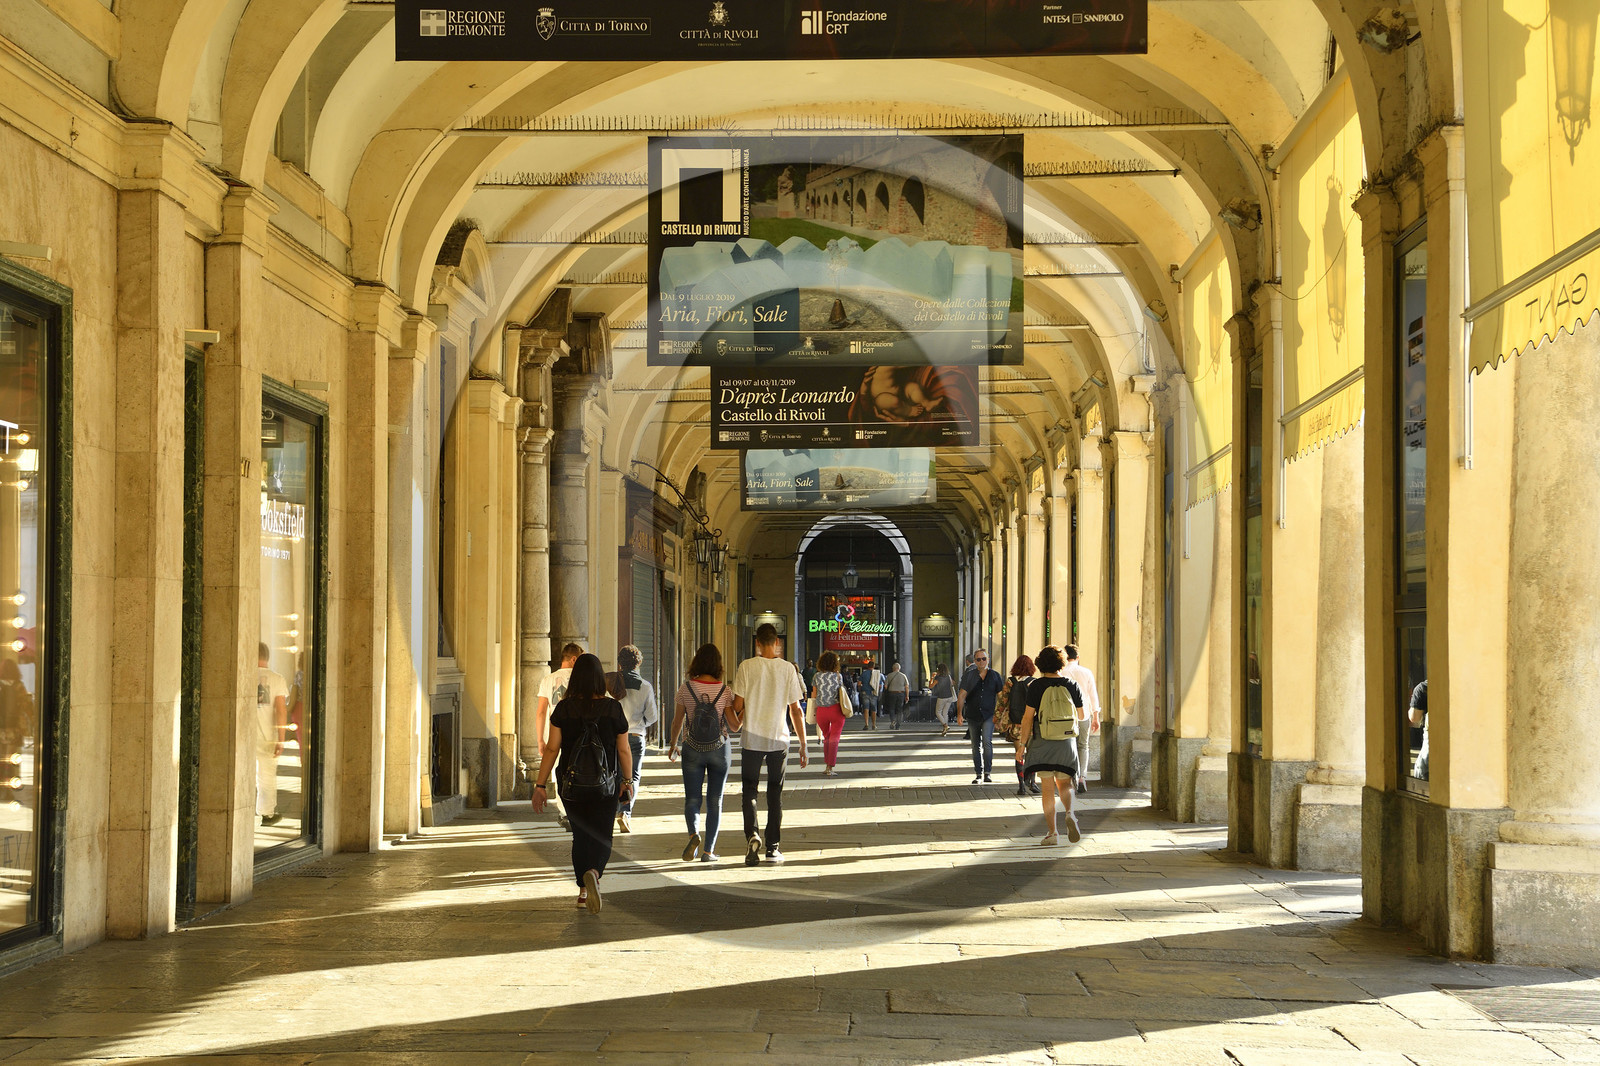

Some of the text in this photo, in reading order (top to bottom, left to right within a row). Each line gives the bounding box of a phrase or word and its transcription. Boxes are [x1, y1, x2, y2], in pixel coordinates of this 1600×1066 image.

[448, 10, 506, 24] REGIONE
[826, 10, 887, 22] Fondazione
[1043, 15, 1070, 24] INTESA
[448, 24, 506, 36] PIEMONTE
[608, 20, 648, 31] TORINO
[826, 24, 849, 35] CRT
[724, 30, 759, 41] RIVOLI
[661, 224, 741, 236] CASTELLO DI RIVOLI
[679, 293, 685, 302] 9
[716, 293, 736, 302] 2019
[914, 297, 1012, 311] Opere dalle Collezioni
[658, 304, 788, 325] Aria, Fiori, Sale
[914, 310, 1004, 322] del Castello di Rivoli
[673, 340, 702, 348] REGIONE
[720, 379, 796, 388] Dal 09/07 al 03/11/2019
[719, 386, 855, 409] D'après Leonardo
[721, 408, 826, 421] Castello di Rivoli
[746, 476, 814, 489] Aria, Fiori, Sale
[261, 498, 305, 539] ooksfield
[808, 619, 895, 633] BAR Gelateria
